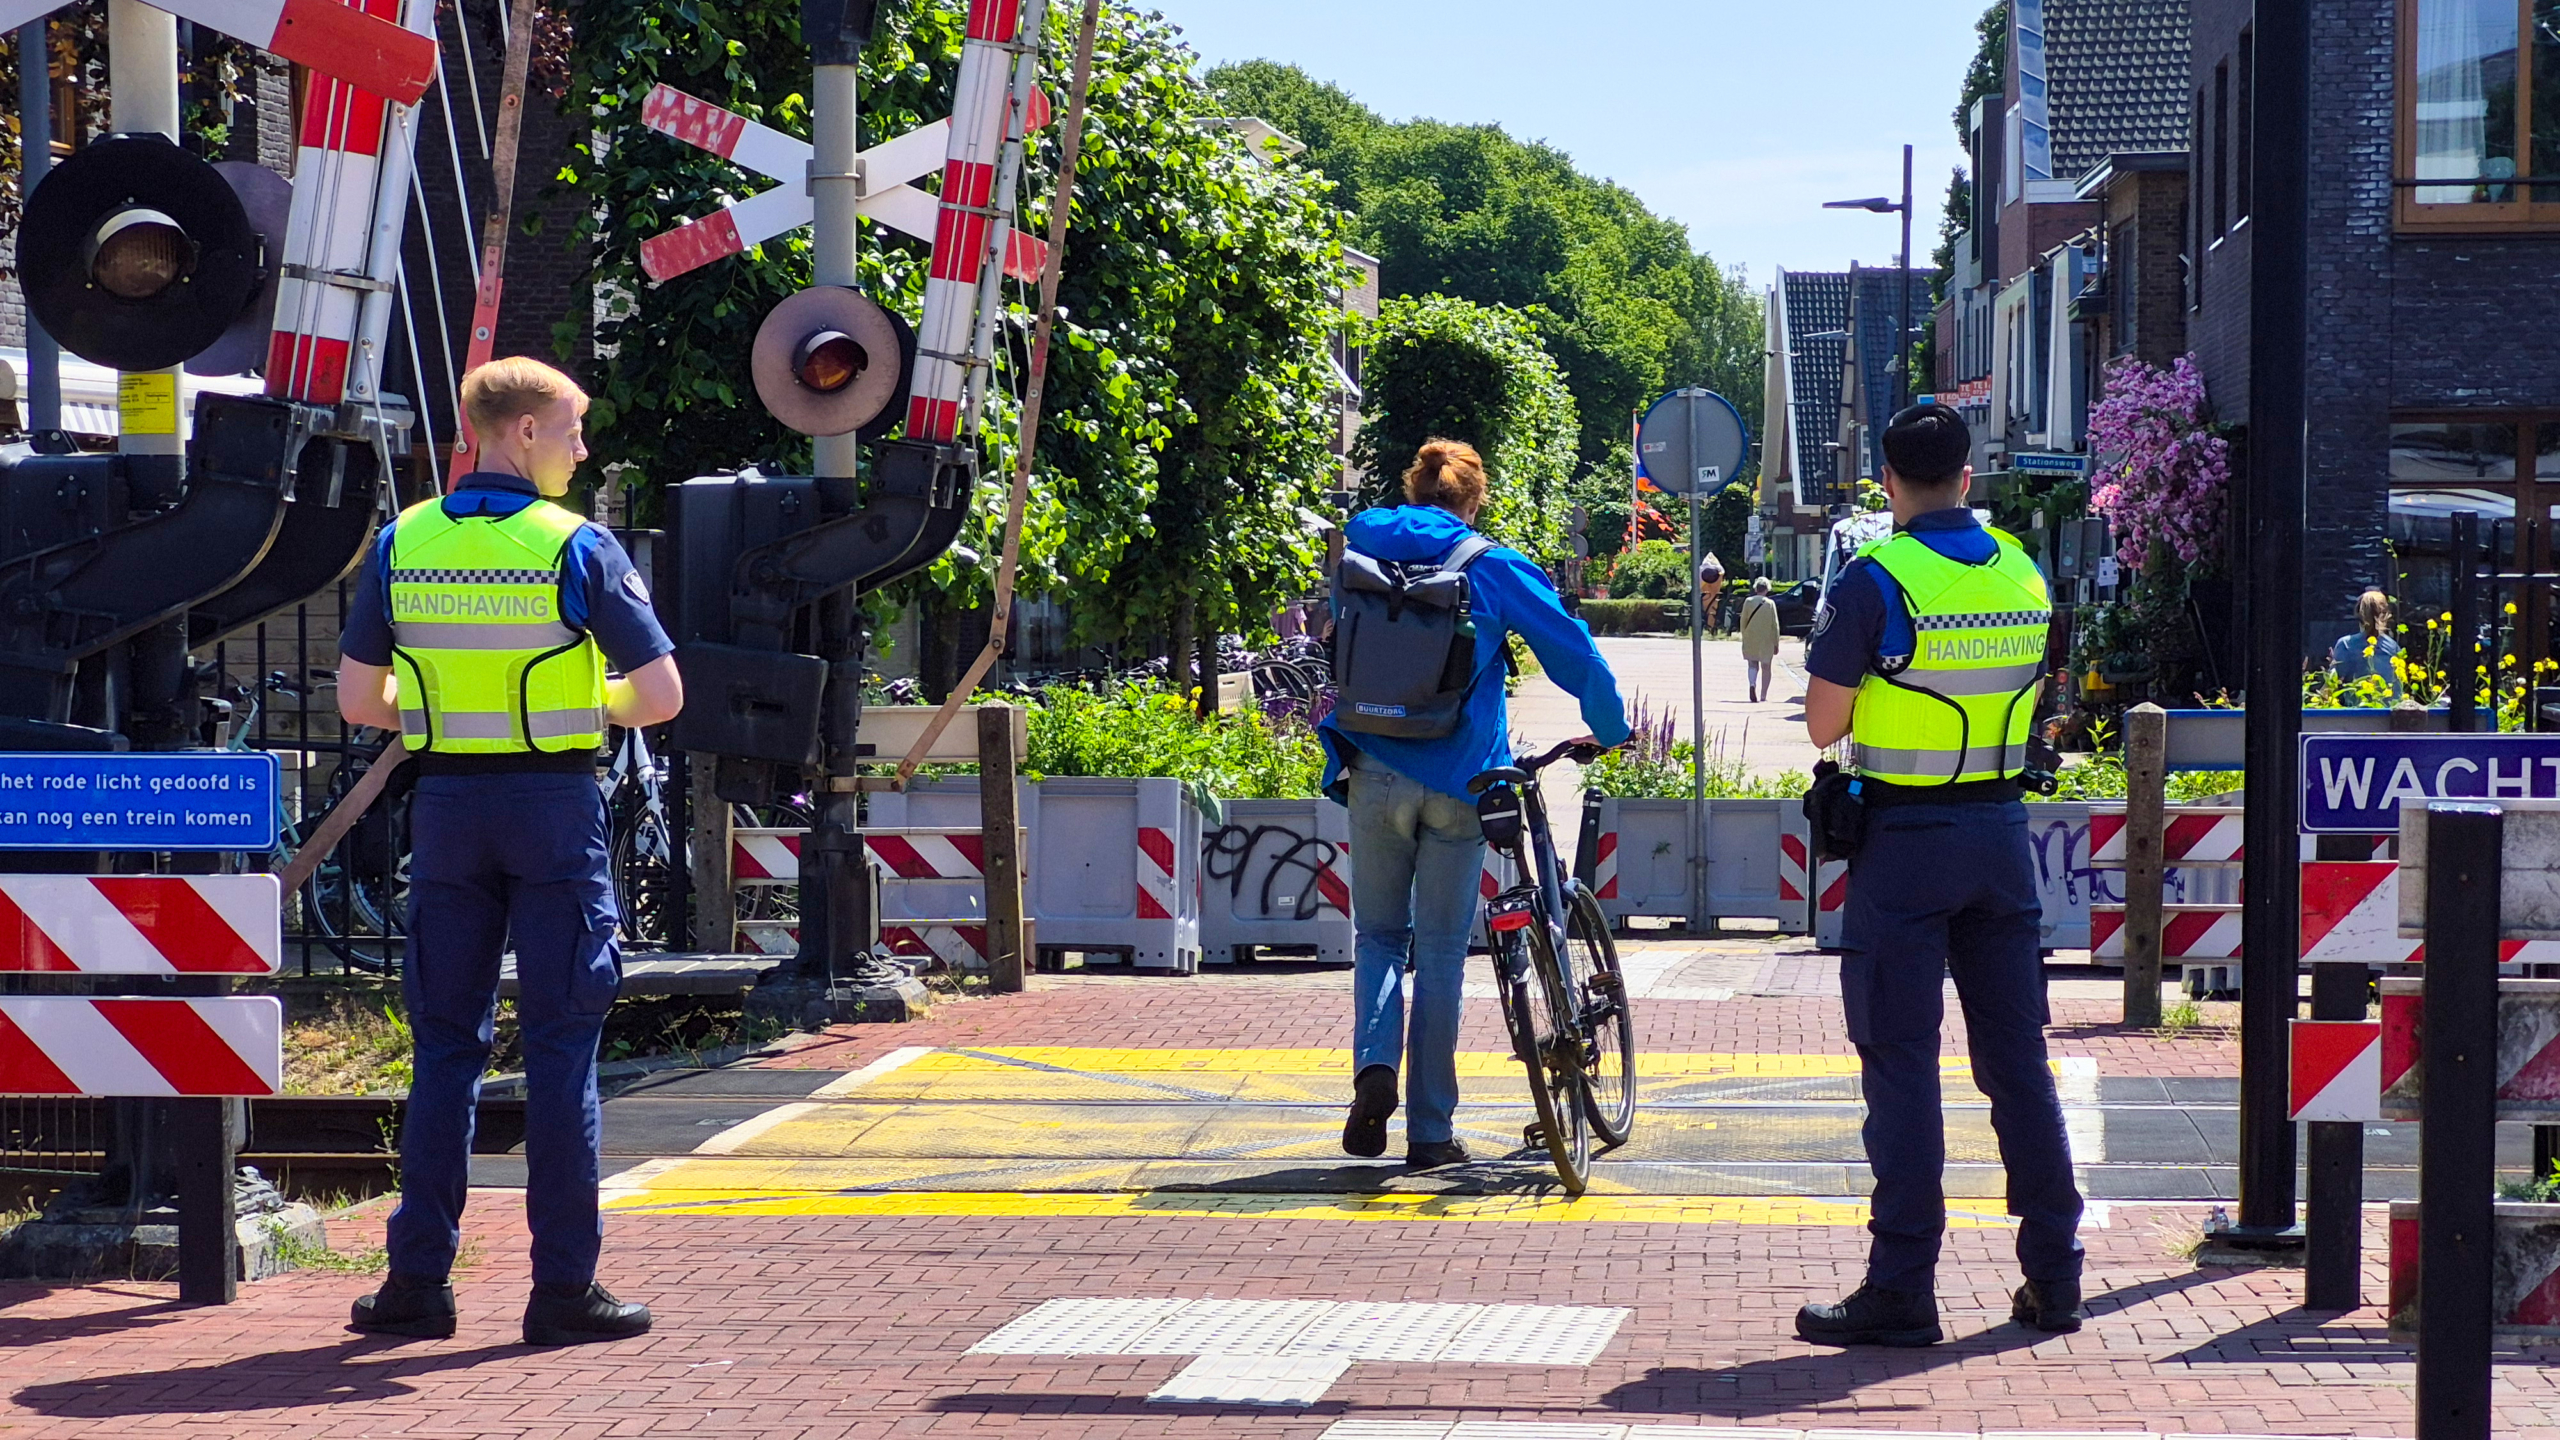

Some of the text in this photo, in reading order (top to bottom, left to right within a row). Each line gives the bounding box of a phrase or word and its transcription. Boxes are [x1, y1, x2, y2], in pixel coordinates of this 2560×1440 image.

[2023, 457, 2077, 469] Stationsweg
[395, 592, 548, 617] HANDHAVING
[1927, 633, 2046, 661] HANDHAVING
[1358, 705, 1403, 715] BUURTZORG
[1, 772, 256, 794] het rode licht gedoofd is
[37, 811, 73, 829] nog
[82, 812, 118, 825] een
[126, 810, 176, 825] trein
[185, 810, 252, 825] komen
